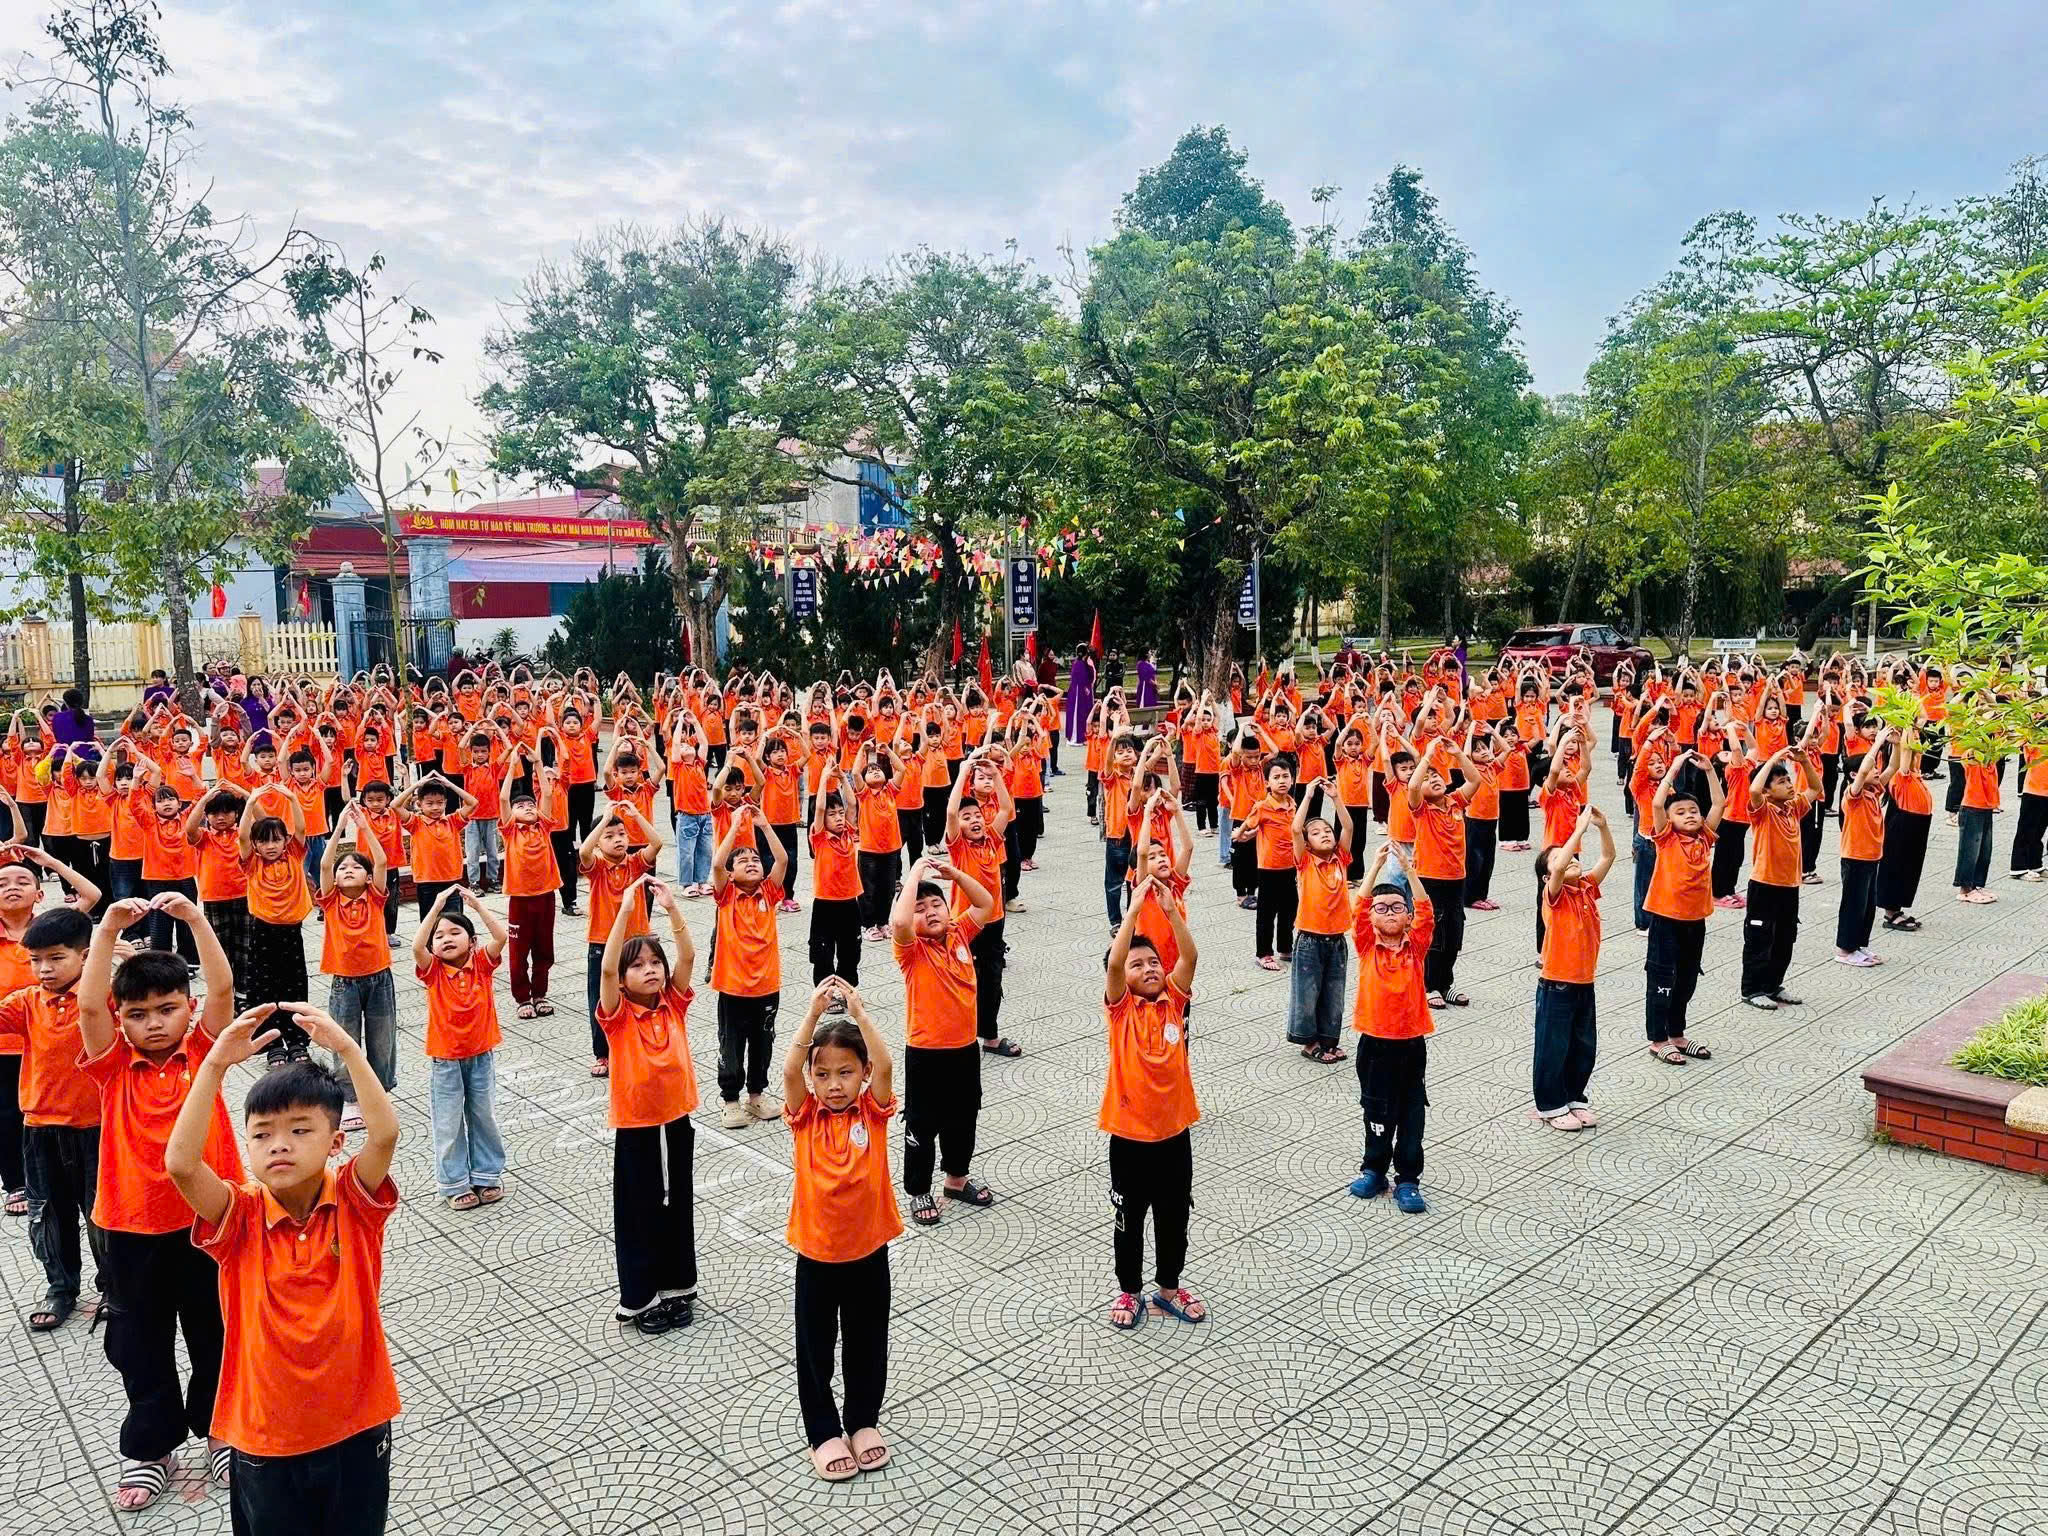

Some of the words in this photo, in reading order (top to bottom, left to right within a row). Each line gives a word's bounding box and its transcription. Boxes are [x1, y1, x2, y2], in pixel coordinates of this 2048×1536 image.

[470, 520, 480, 531] EM
[1657, 986, 1672, 997] XT
[1370, 1121, 1385, 1136] EP
